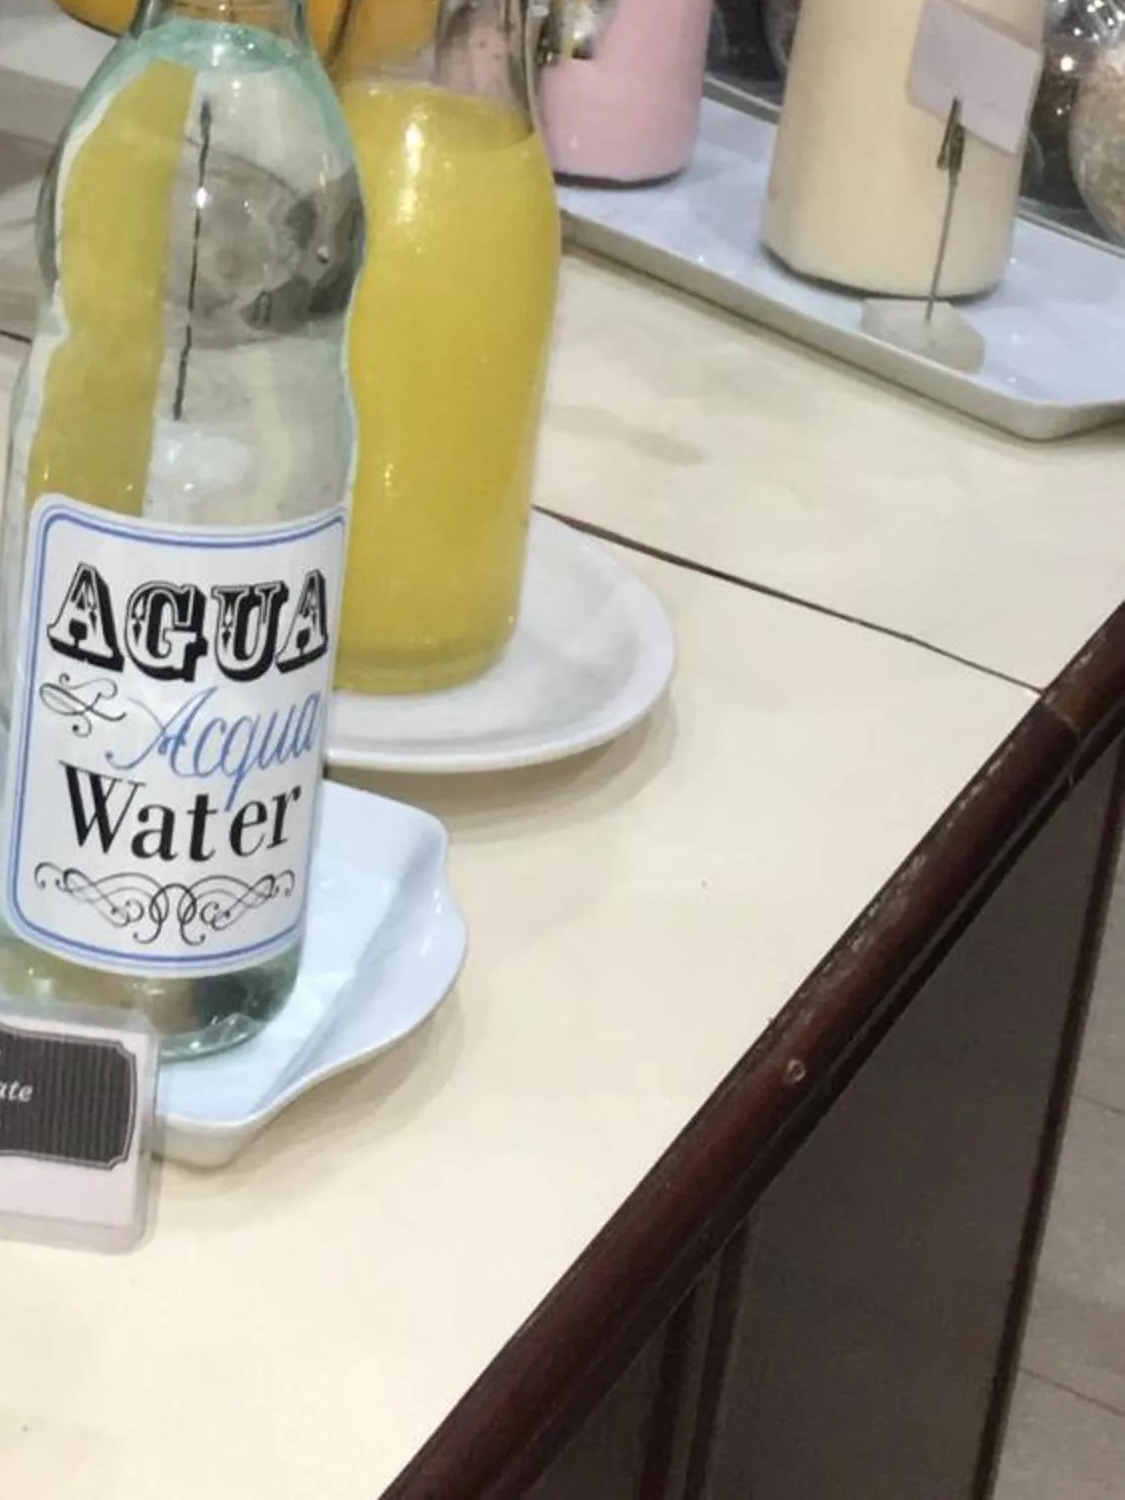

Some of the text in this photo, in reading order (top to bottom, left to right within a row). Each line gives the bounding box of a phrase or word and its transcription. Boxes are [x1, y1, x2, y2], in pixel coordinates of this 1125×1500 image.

[45, 561, 330, 683] AGUA
[104, 685, 322, 811] Acqua
[59, 758, 303, 864] Water
